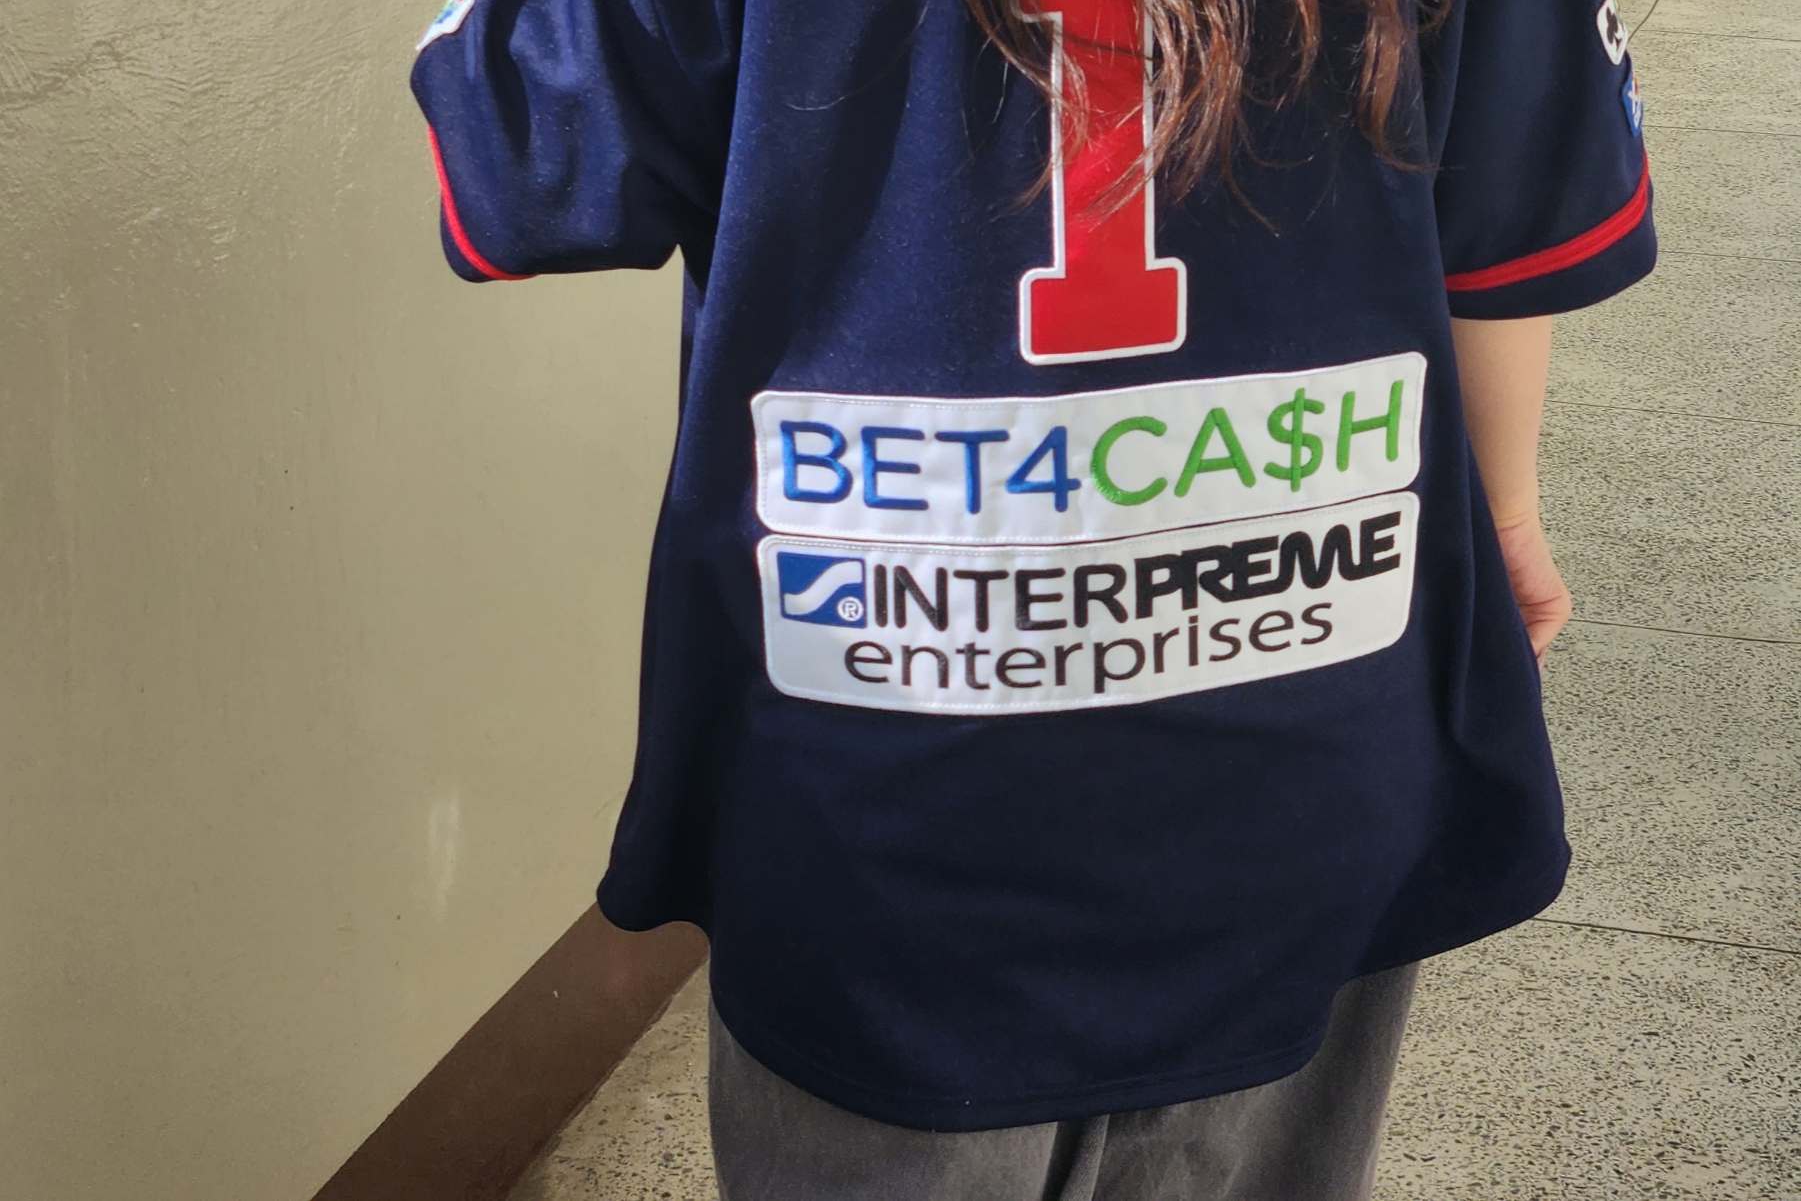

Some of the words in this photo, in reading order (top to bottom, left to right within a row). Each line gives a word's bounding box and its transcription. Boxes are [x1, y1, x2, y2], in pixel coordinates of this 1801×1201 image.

[779, 379, 1404, 516] BET4CA$H
[873, 510, 1402, 633] INTERPREME
[844, 601, 1333, 694] enterprises
